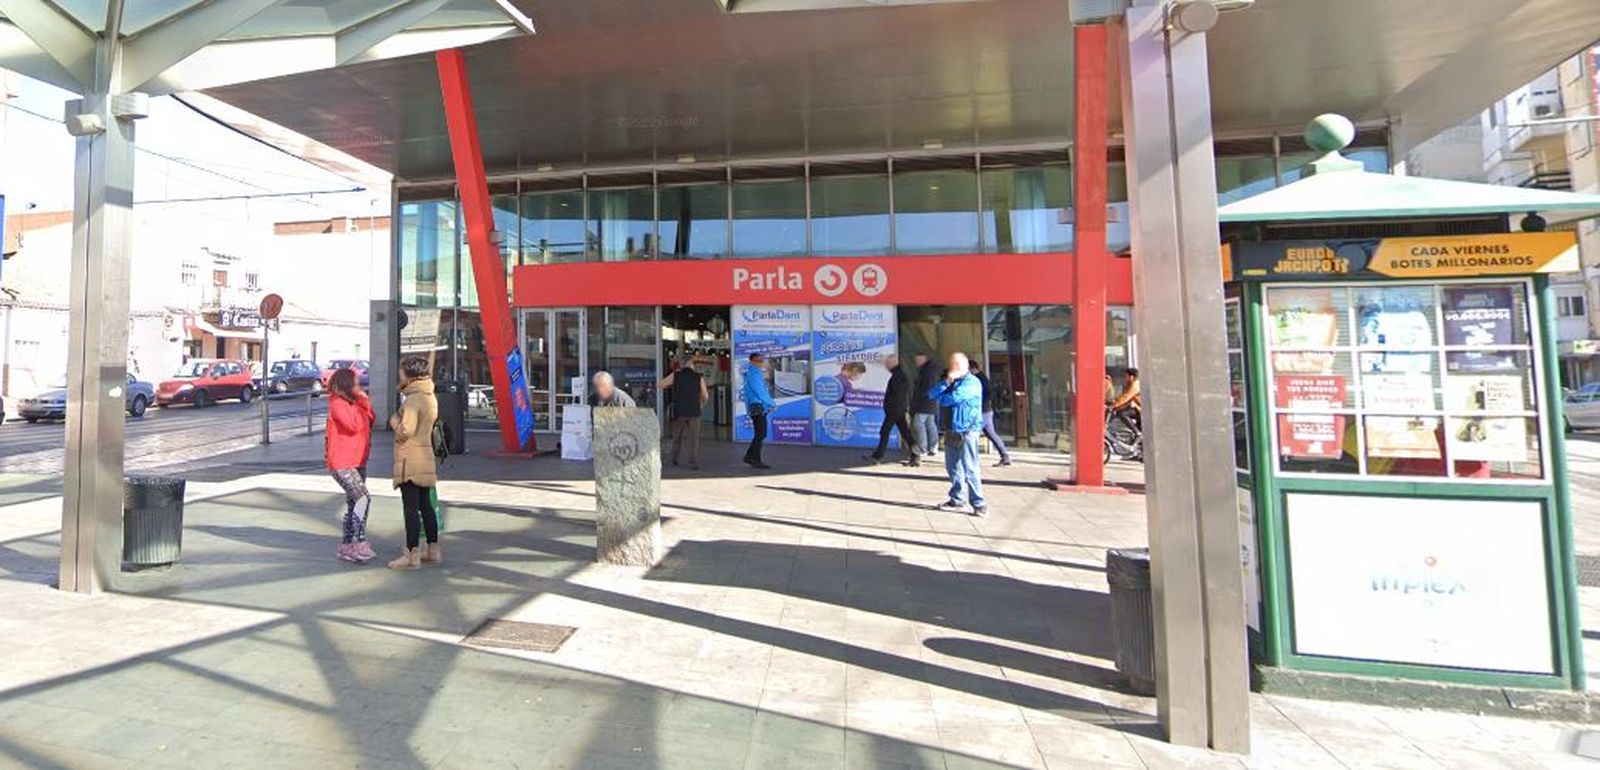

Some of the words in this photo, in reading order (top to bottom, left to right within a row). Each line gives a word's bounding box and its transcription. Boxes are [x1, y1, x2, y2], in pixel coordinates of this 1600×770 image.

[1410, 246, 1449, 257] CADA
[1453, 244, 1510, 255] VIERNES
[1390, 259, 1432, 270] BOTES
[1436, 255, 1535, 269] MILLONARIOS
[733, 265, 803, 290] Parla
